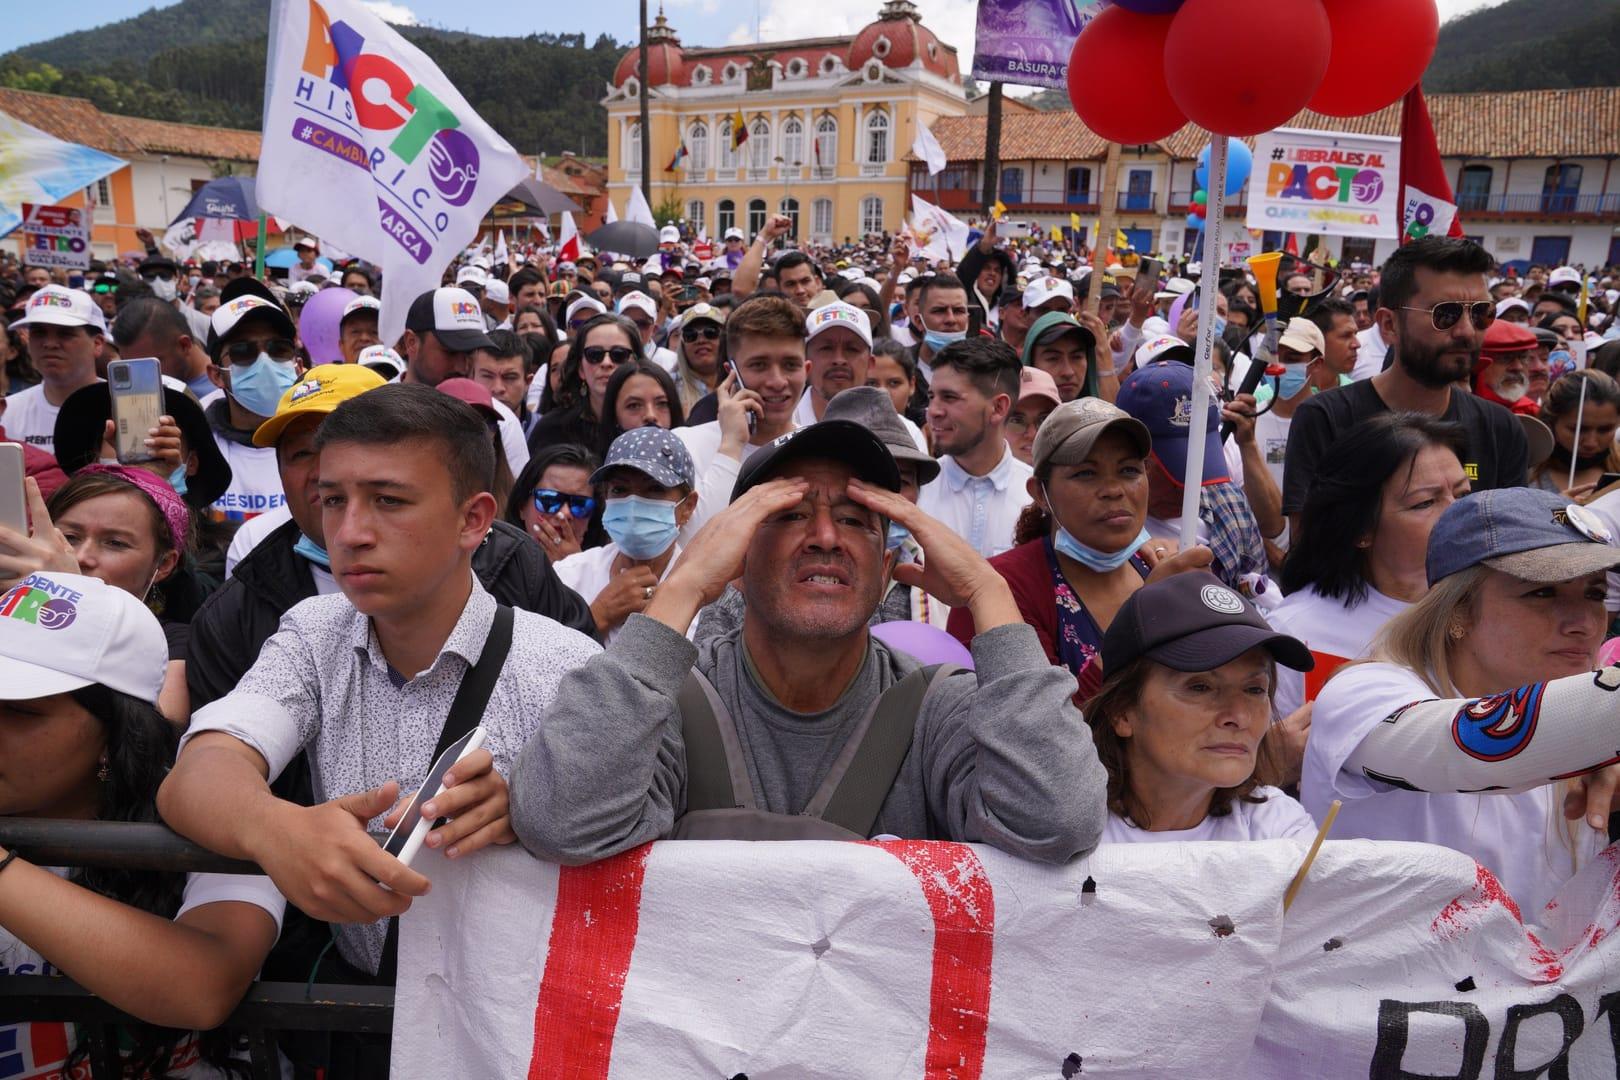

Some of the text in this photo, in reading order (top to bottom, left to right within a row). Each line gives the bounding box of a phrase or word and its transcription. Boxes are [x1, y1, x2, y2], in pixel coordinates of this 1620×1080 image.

[1008, 60, 1057, 77] BASURA
[1265, 162, 1385, 204] PACTO
[25, 232, 86, 254] PETRO
